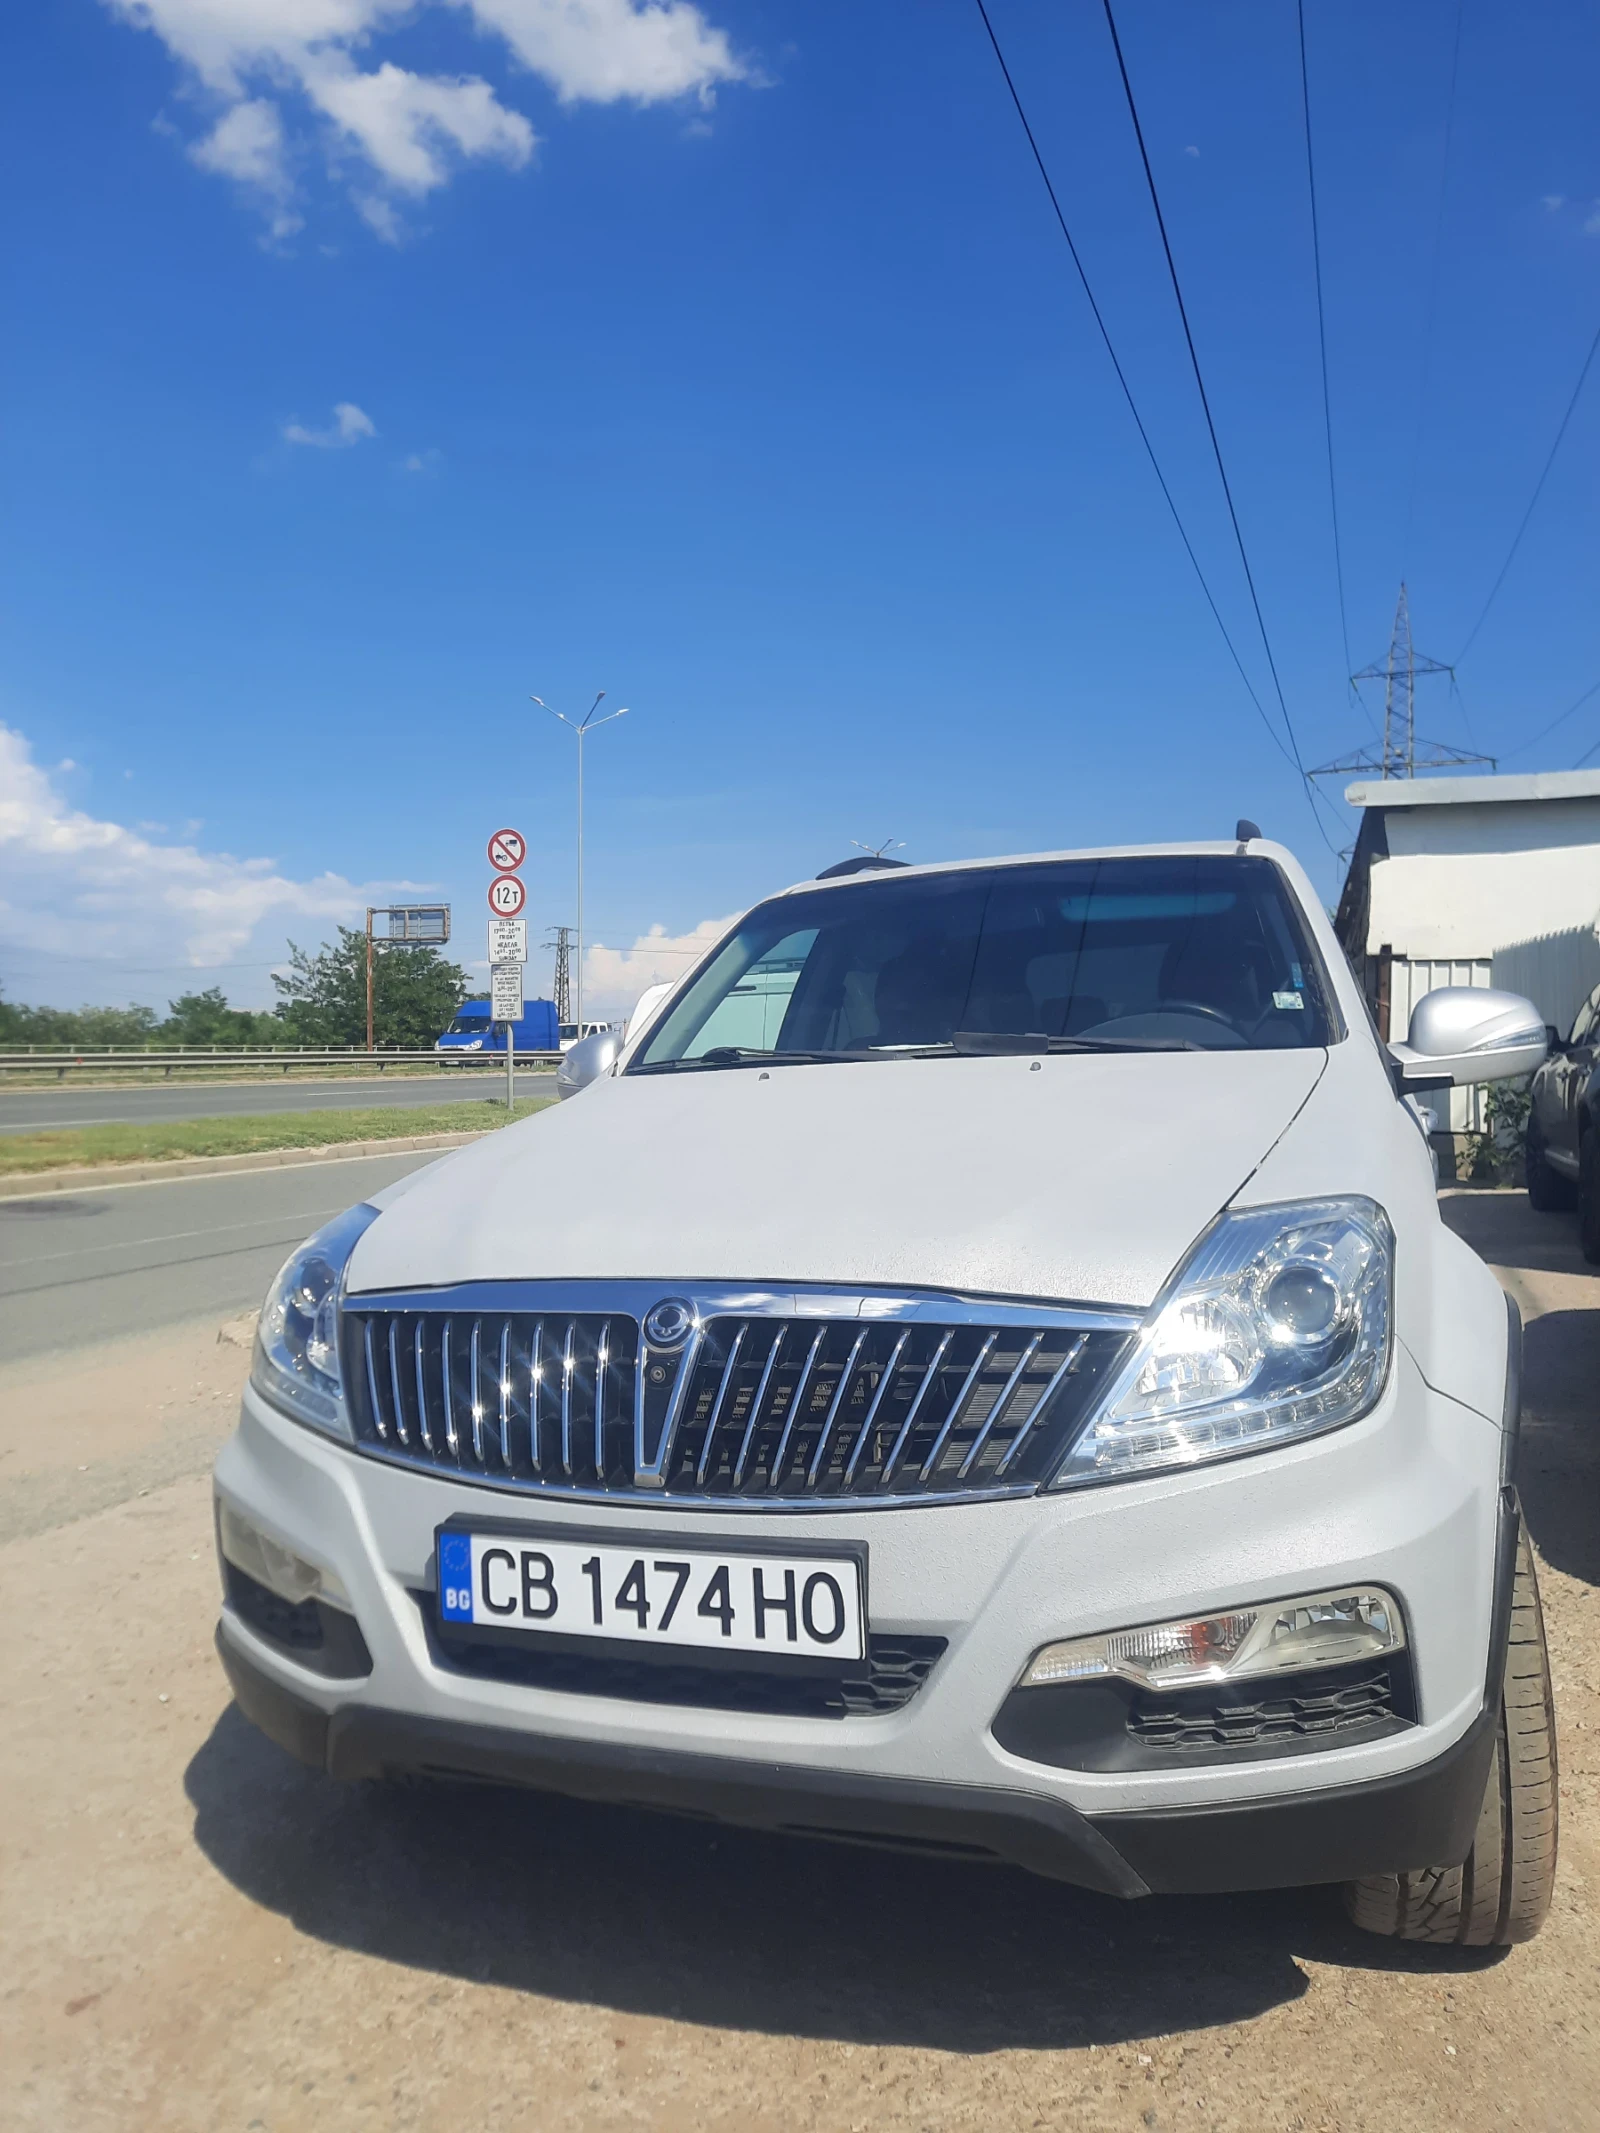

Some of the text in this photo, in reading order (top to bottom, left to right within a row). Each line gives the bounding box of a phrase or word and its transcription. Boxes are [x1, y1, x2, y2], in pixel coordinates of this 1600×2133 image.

[446, 1588, 470, 1610] BG
[480, 1547, 845, 1644] CB 1474 HO
